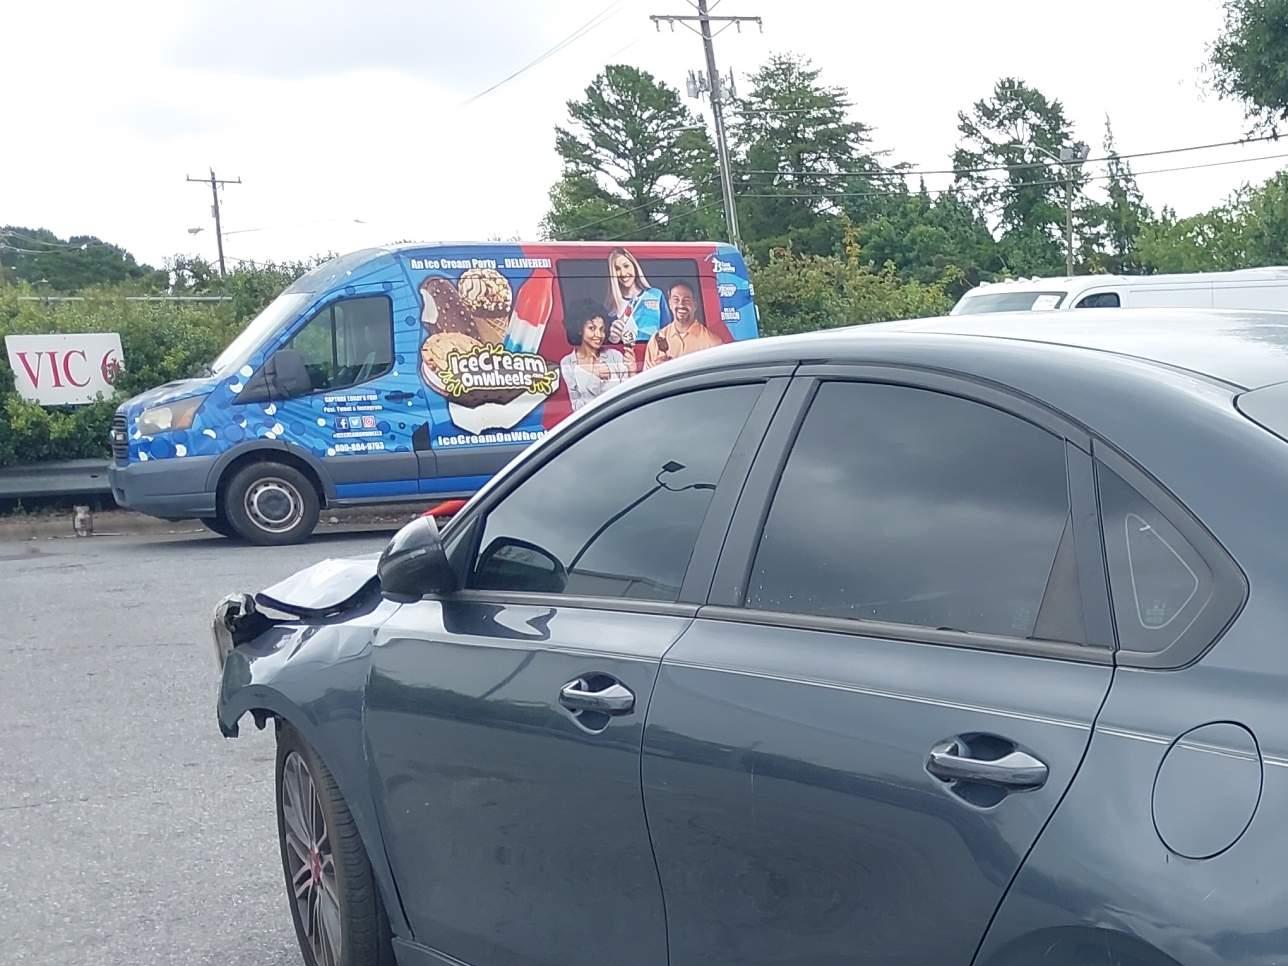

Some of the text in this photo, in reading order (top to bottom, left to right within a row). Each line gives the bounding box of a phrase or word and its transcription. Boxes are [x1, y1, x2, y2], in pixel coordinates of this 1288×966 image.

[411, 259, 424, 270] An
[425, 258, 440, 270] Ice
[441, 258, 472, 270] Cream
[472, 258, 496, 271] Party
[16, 349, 91, 389] VIC
[451, 351, 545, 374] IceCream
[461, 372, 533, 388] OnWheels
